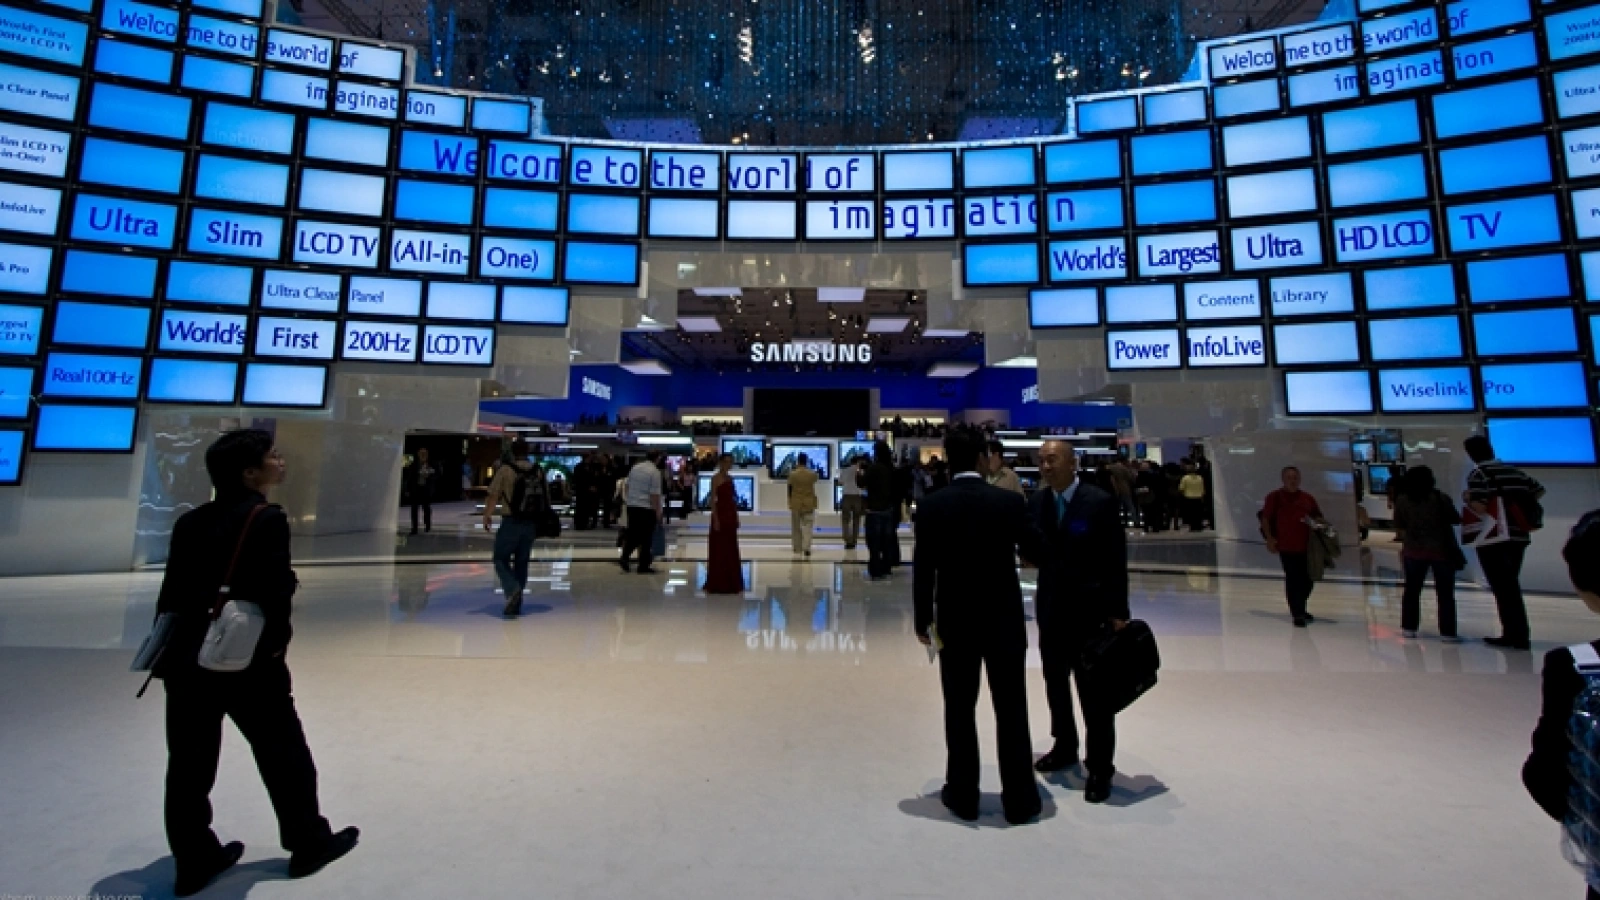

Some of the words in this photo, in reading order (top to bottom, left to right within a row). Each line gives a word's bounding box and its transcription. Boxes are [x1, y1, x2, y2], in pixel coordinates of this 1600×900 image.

[119, 8, 215, 44] Welcome
[218, 29, 237, 48] to
[279, 43, 328, 64] world
[340, 51, 359, 69] of
[1222, 43, 1310, 72] Welcome
[1312, 40, 1332, 56] to
[1376, 17, 1433, 45] world
[1448, 8, 1470, 31] of
[1334, 50, 1494, 92] imagination
[305, 82, 436, 116] imagination
[0, 134, 19, 147] lim
[433, 139, 593, 183] Welcome
[605, 156, 637, 184] to
[652, 156, 706, 187] the
[825, 158, 860, 189] of
[89, 206, 159, 237] Ultra
[206, 220, 263, 248] Slim
[299, 230, 344, 255] LCD
[350, 235, 378, 258] TV
[1053, 246, 1127, 272] World's
[1147, 242, 1220, 272] Largest
[1247, 233, 1303, 260] Ultra
[1339, 225, 1377, 252] HD
[1382, 220, 1431, 248] LCD
[1460, 210, 1502, 240] TV
[267, 283, 300, 299] Ultra
[303, 286, 341, 301] Clear
[351, 288, 385, 304] Panel
[1197, 292, 1255, 307] Content
[1273, 288, 1328, 303] Library
[165, 318, 246, 347] World's
[271, 326, 320, 350] First
[348, 330, 411, 354] 200Hz
[427, 334, 460, 356] LCD
[462, 336, 488, 356] TV
[751, 341, 872, 363] SAMSUNG
[1114, 339, 1170, 360] Power
[1187, 334, 1262, 358] InfoLive
[51, 367, 134, 386] Real100Hz
[1391, 381, 1469, 398] Wiselink
[1483, 380, 1515, 395] Pro
